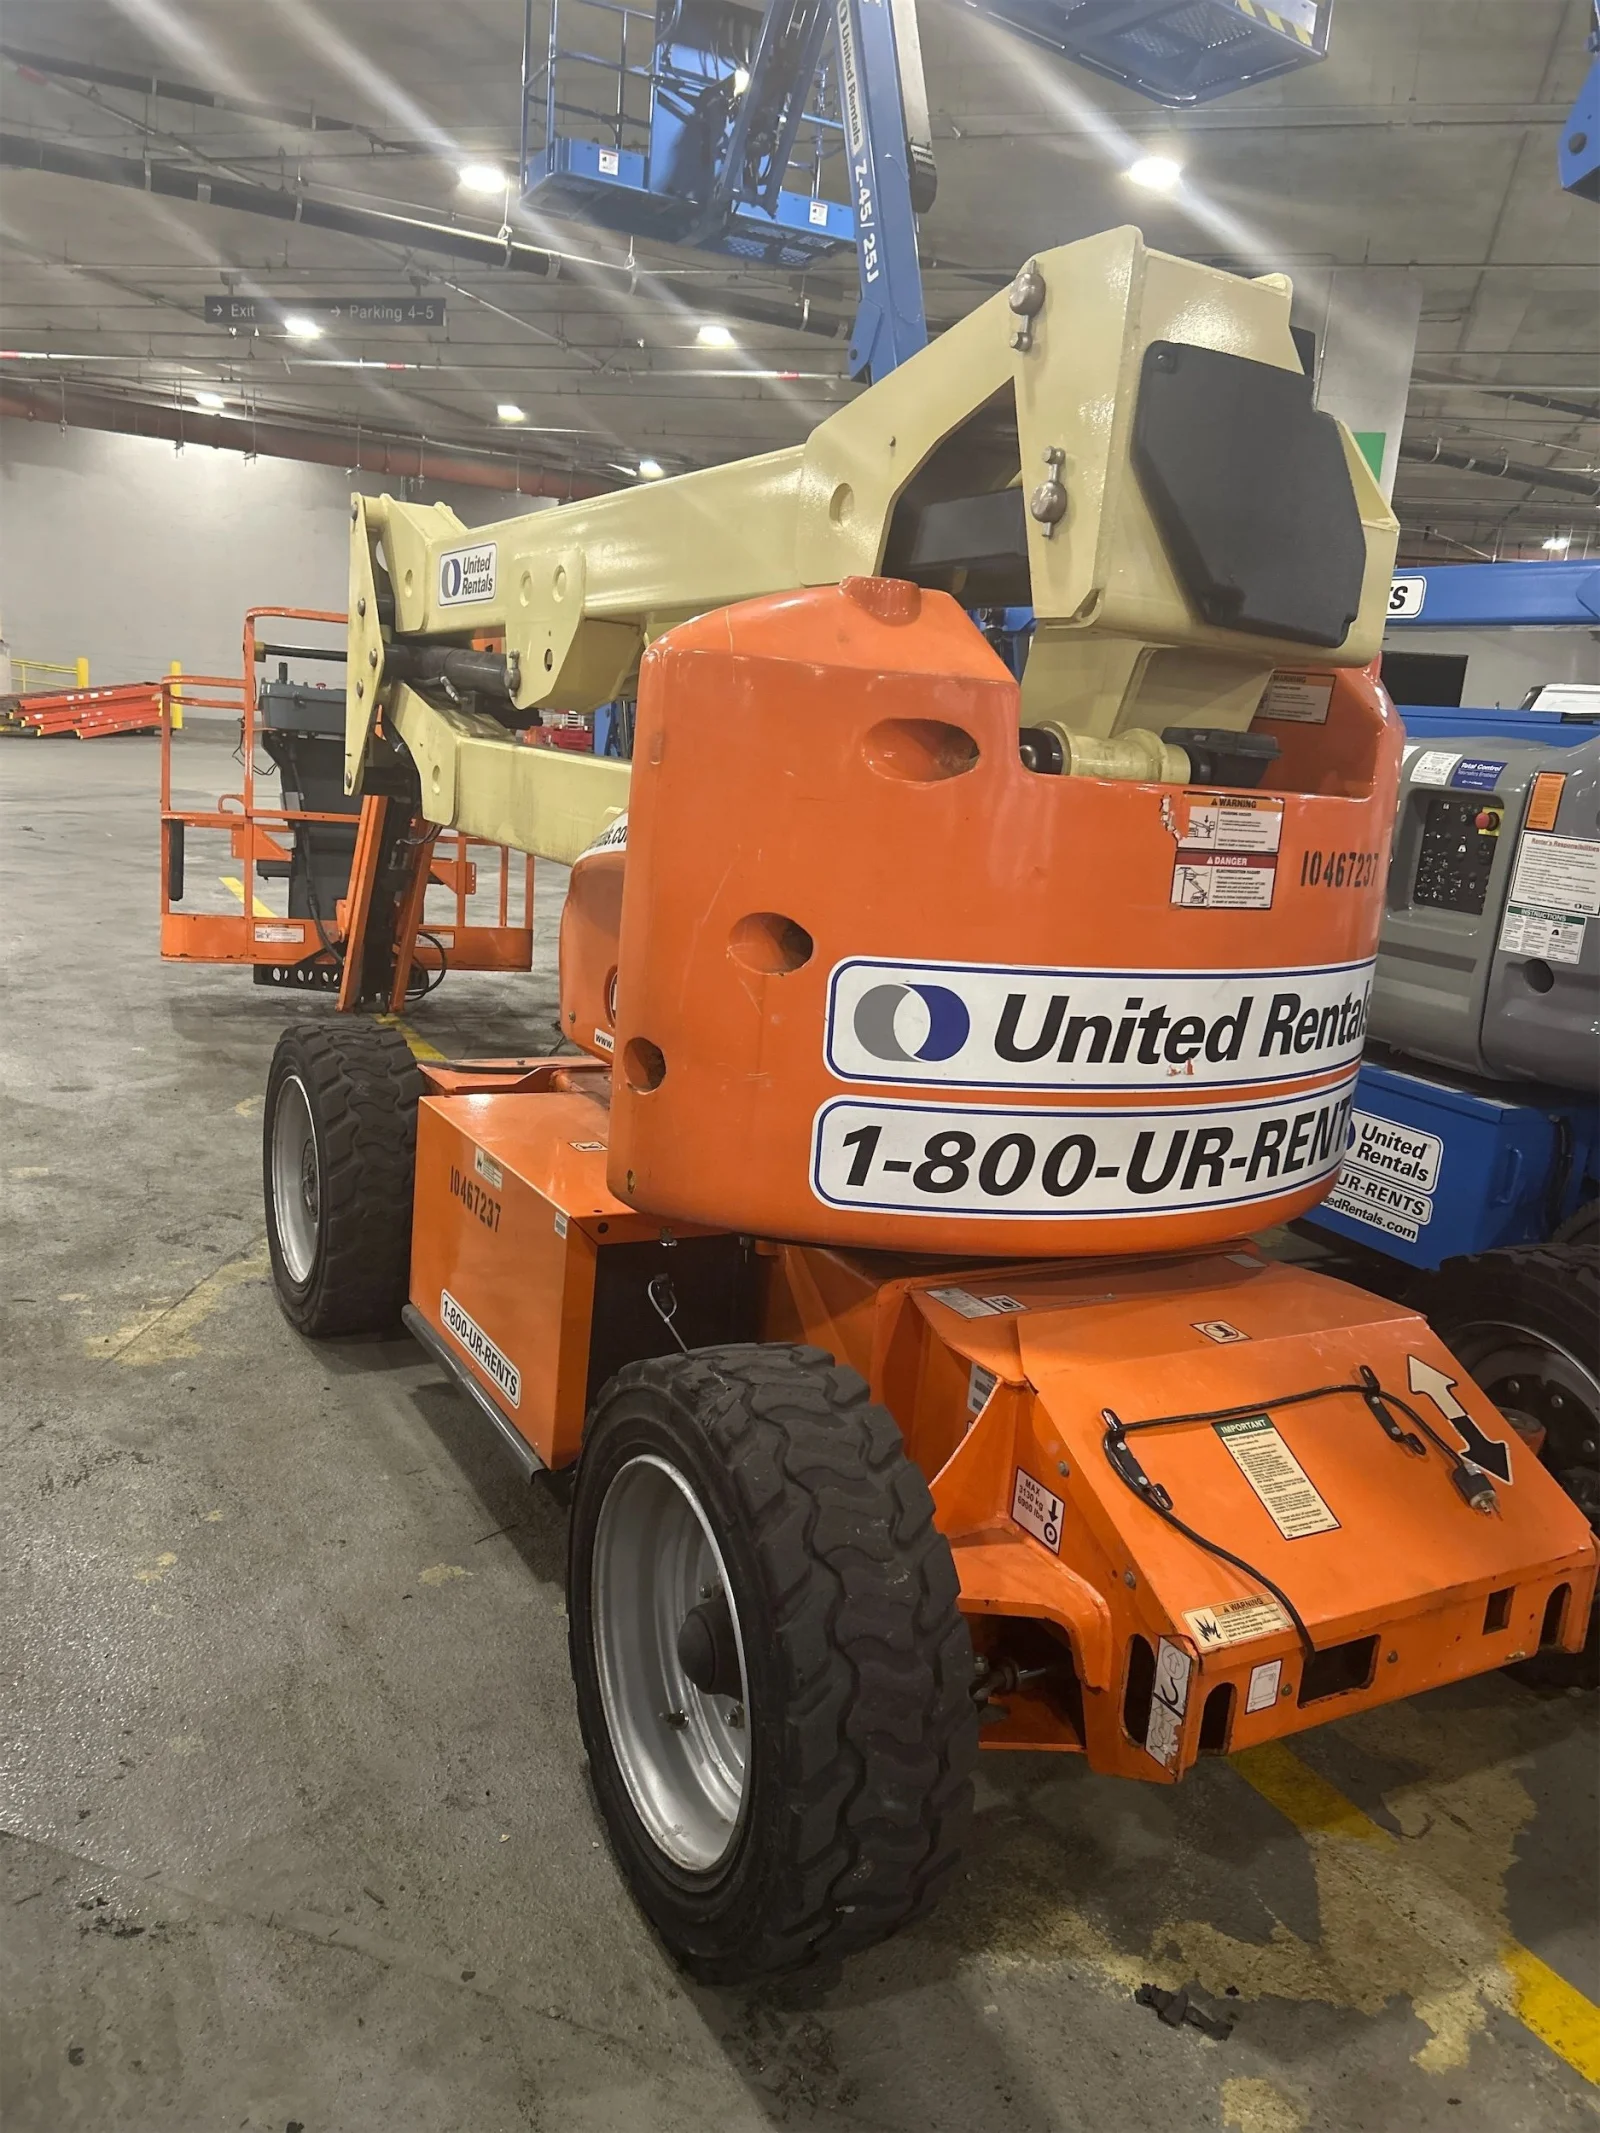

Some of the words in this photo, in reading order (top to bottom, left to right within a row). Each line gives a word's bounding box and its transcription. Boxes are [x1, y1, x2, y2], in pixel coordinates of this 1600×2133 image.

[841, 24, 855, 81] United
[848, 84, 860, 145] Rentals
[231, 303, 255, 318] Exit
[350, 304, 402, 322] Parking
[463, 552, 491, 575] United
[462, 573, 493, 595] Rentals
[1477, 764, 1502, 772] Control
[1219, 798, 1257, 808] WARNING
[1214, 856, 1248, 866] DANGER
[1521, 908, 1567, 922] INSTRUCTIONS
[994, 995, 1254, 1065] United
[840, 1093, 1352, 1200] 1-800-UR-RENT
[1361, 1122, 1428, 1160] United
[1356, 1142, 1429, 1182] Rentals
[443, 1300, 518, 1398] 1-800-UR-RENTS
[1221, 1419, 1267, 1434] IMPORTANT
[1025, 1479, 1041, 1496] MAX
[1019, 1485, 1034, 1502] 3130
[1035, 1499, 1043, 1512] kg
[1033, 1508, 1044, 1522] lbs
[1230, 1598, 1264, 1612] WARNING
